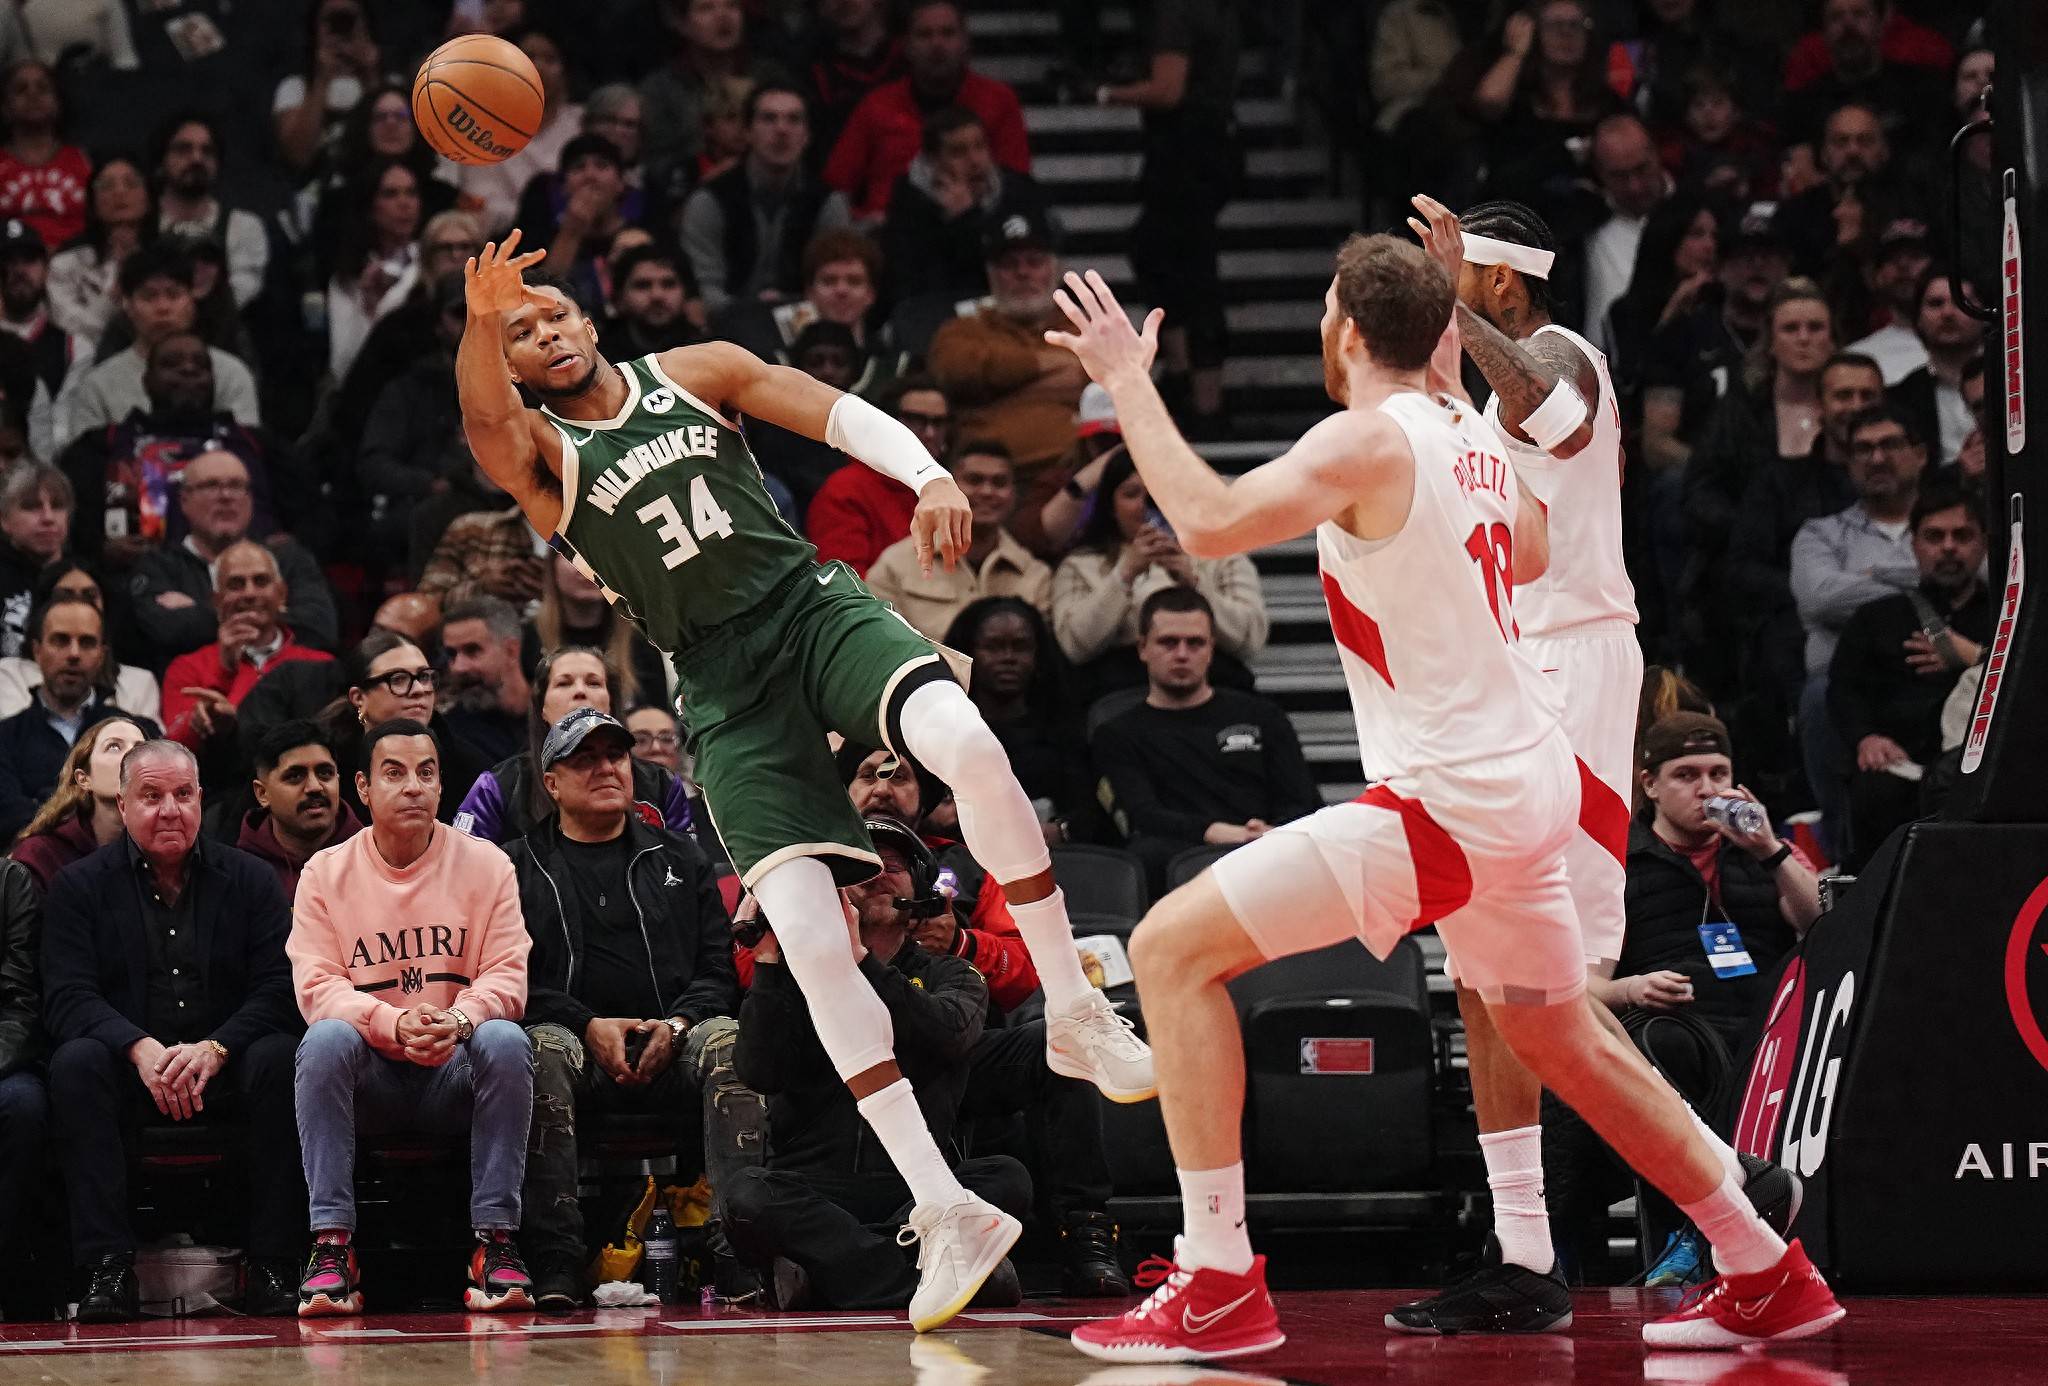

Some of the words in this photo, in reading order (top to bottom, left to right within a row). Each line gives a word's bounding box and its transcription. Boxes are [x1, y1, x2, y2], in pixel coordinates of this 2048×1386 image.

[447, 104, 516, 156] Wilson
[2005, 257, 2021, 428] PRIME
[586, 425, 718, 516] MILWAUKEE
[635, 474, 735, 571] 34
[1968, 582, 2020, 748] PRIME
[348, 925, 467, 968] AMIRI
[1781, 970, 1854, 1177] LG
[1955, 1143, 2048, 1179] AIR
